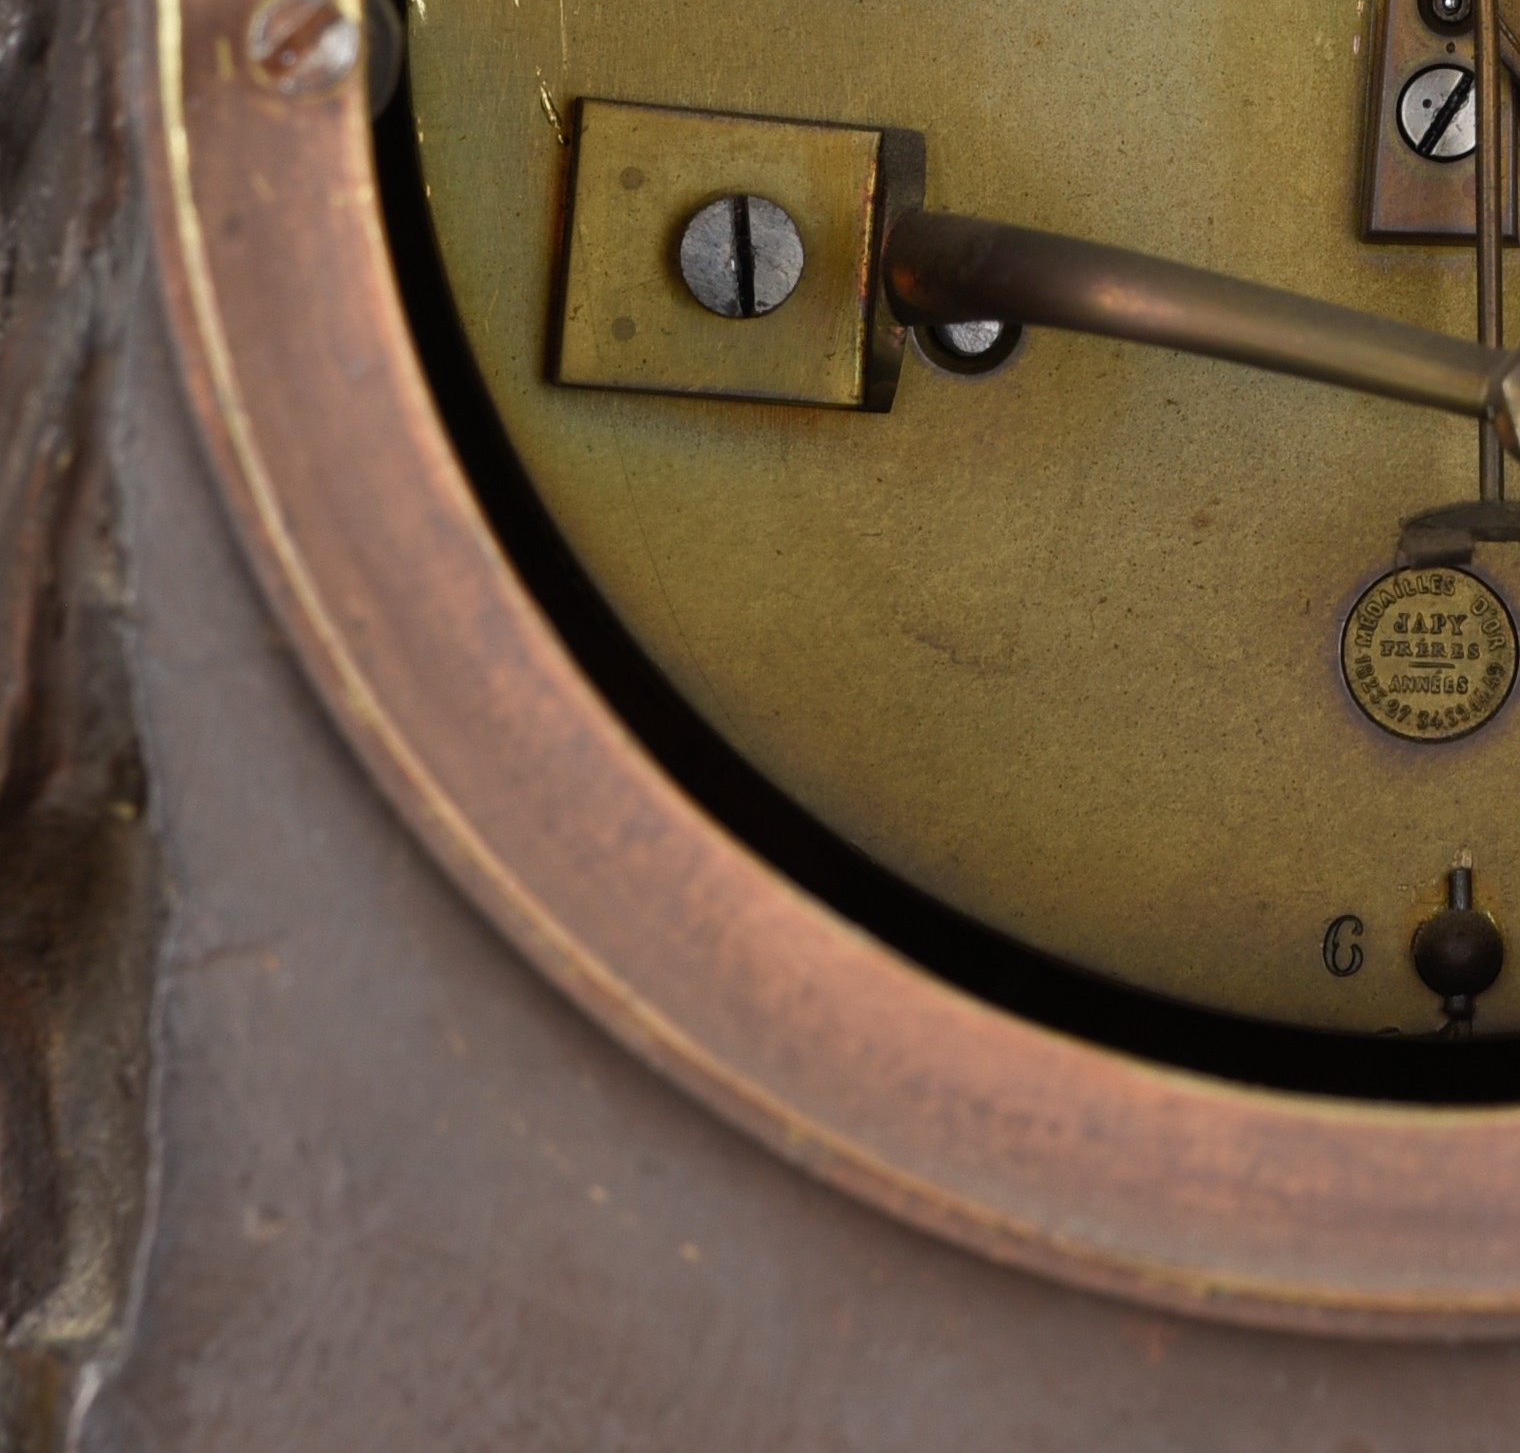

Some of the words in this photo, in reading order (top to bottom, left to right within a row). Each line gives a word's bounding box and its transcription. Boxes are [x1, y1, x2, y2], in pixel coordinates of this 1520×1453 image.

[1393, 612, 1468, 635] JAPY
[1471, 596, 1506, 652] D'OR
[1388, 670, 1469, 694] ANNÉES
